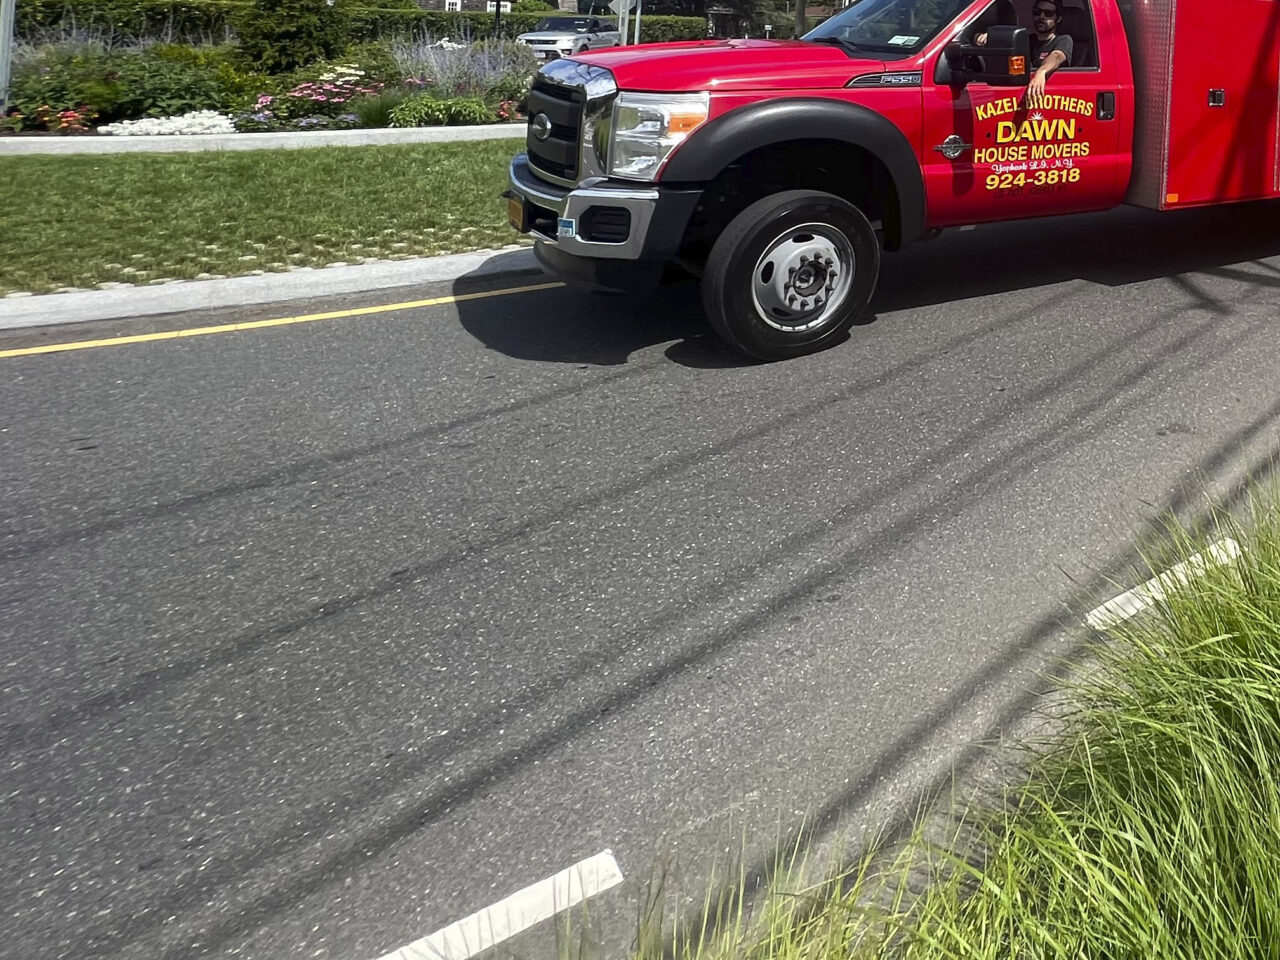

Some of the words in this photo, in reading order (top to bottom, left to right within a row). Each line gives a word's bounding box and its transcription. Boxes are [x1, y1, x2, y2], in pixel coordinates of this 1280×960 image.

[975, 97, 1021, 120] KAZEL
[997, 119, 1076, 143] DAWN
[974, 146, 1028, 163] HOUSE
[1031, 142, 1090, 159] MOVERS
[985, 168, 1080, 190] 924-3818
